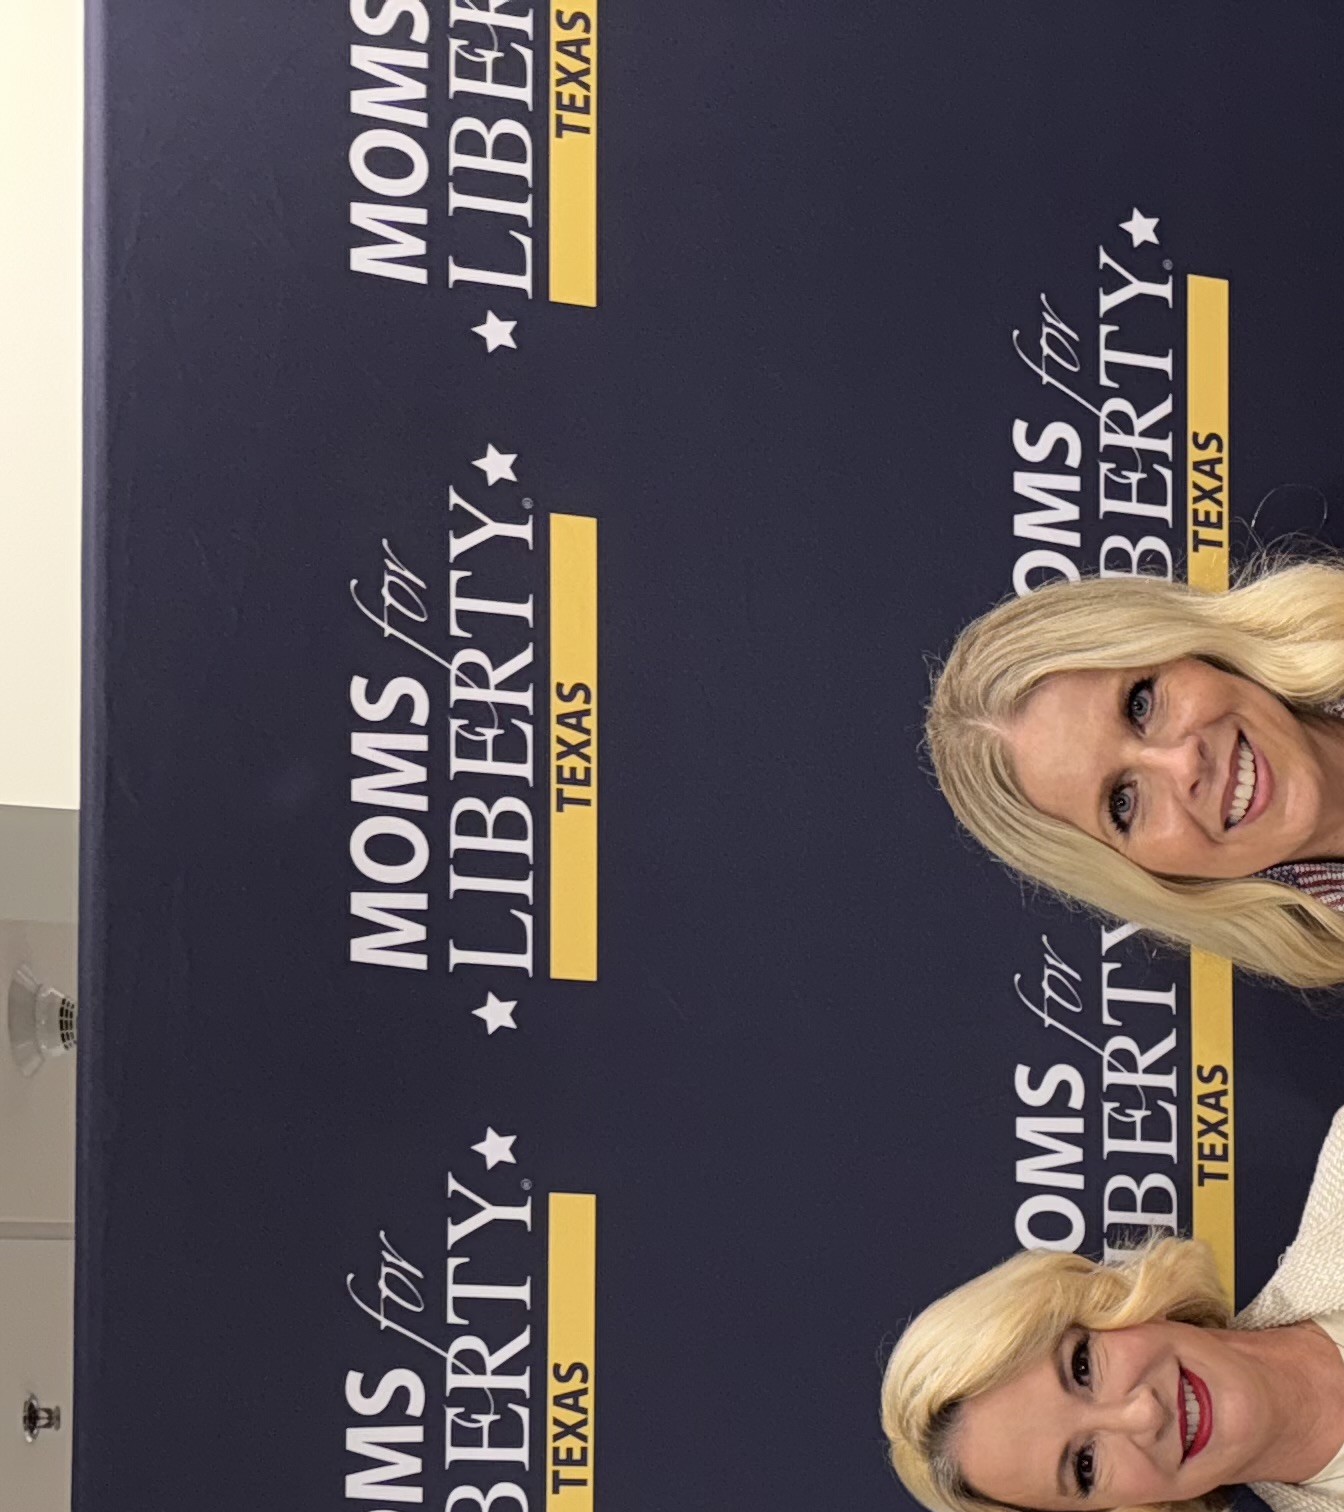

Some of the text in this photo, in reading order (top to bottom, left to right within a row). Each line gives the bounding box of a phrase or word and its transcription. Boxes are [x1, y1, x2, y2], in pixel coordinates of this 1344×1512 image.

[554, 8, 593, 139] TEXAS
[1098, 245, 1175, 584] BERTY
[1192, 430, 1226, 552] TEXAS
[1012, 419, 1083, 597] OMS
[447, 484, 535, 978] LIBERTY
[554, 680, 593, 813] TEXAS
[349, 674, 430, 971] MOMS
[1014, 1063, 1086, 1254] OMS
[1197, 1064, 1229, 1187] TEXAS
[551, 1360, 590, 1494] TEXAS
